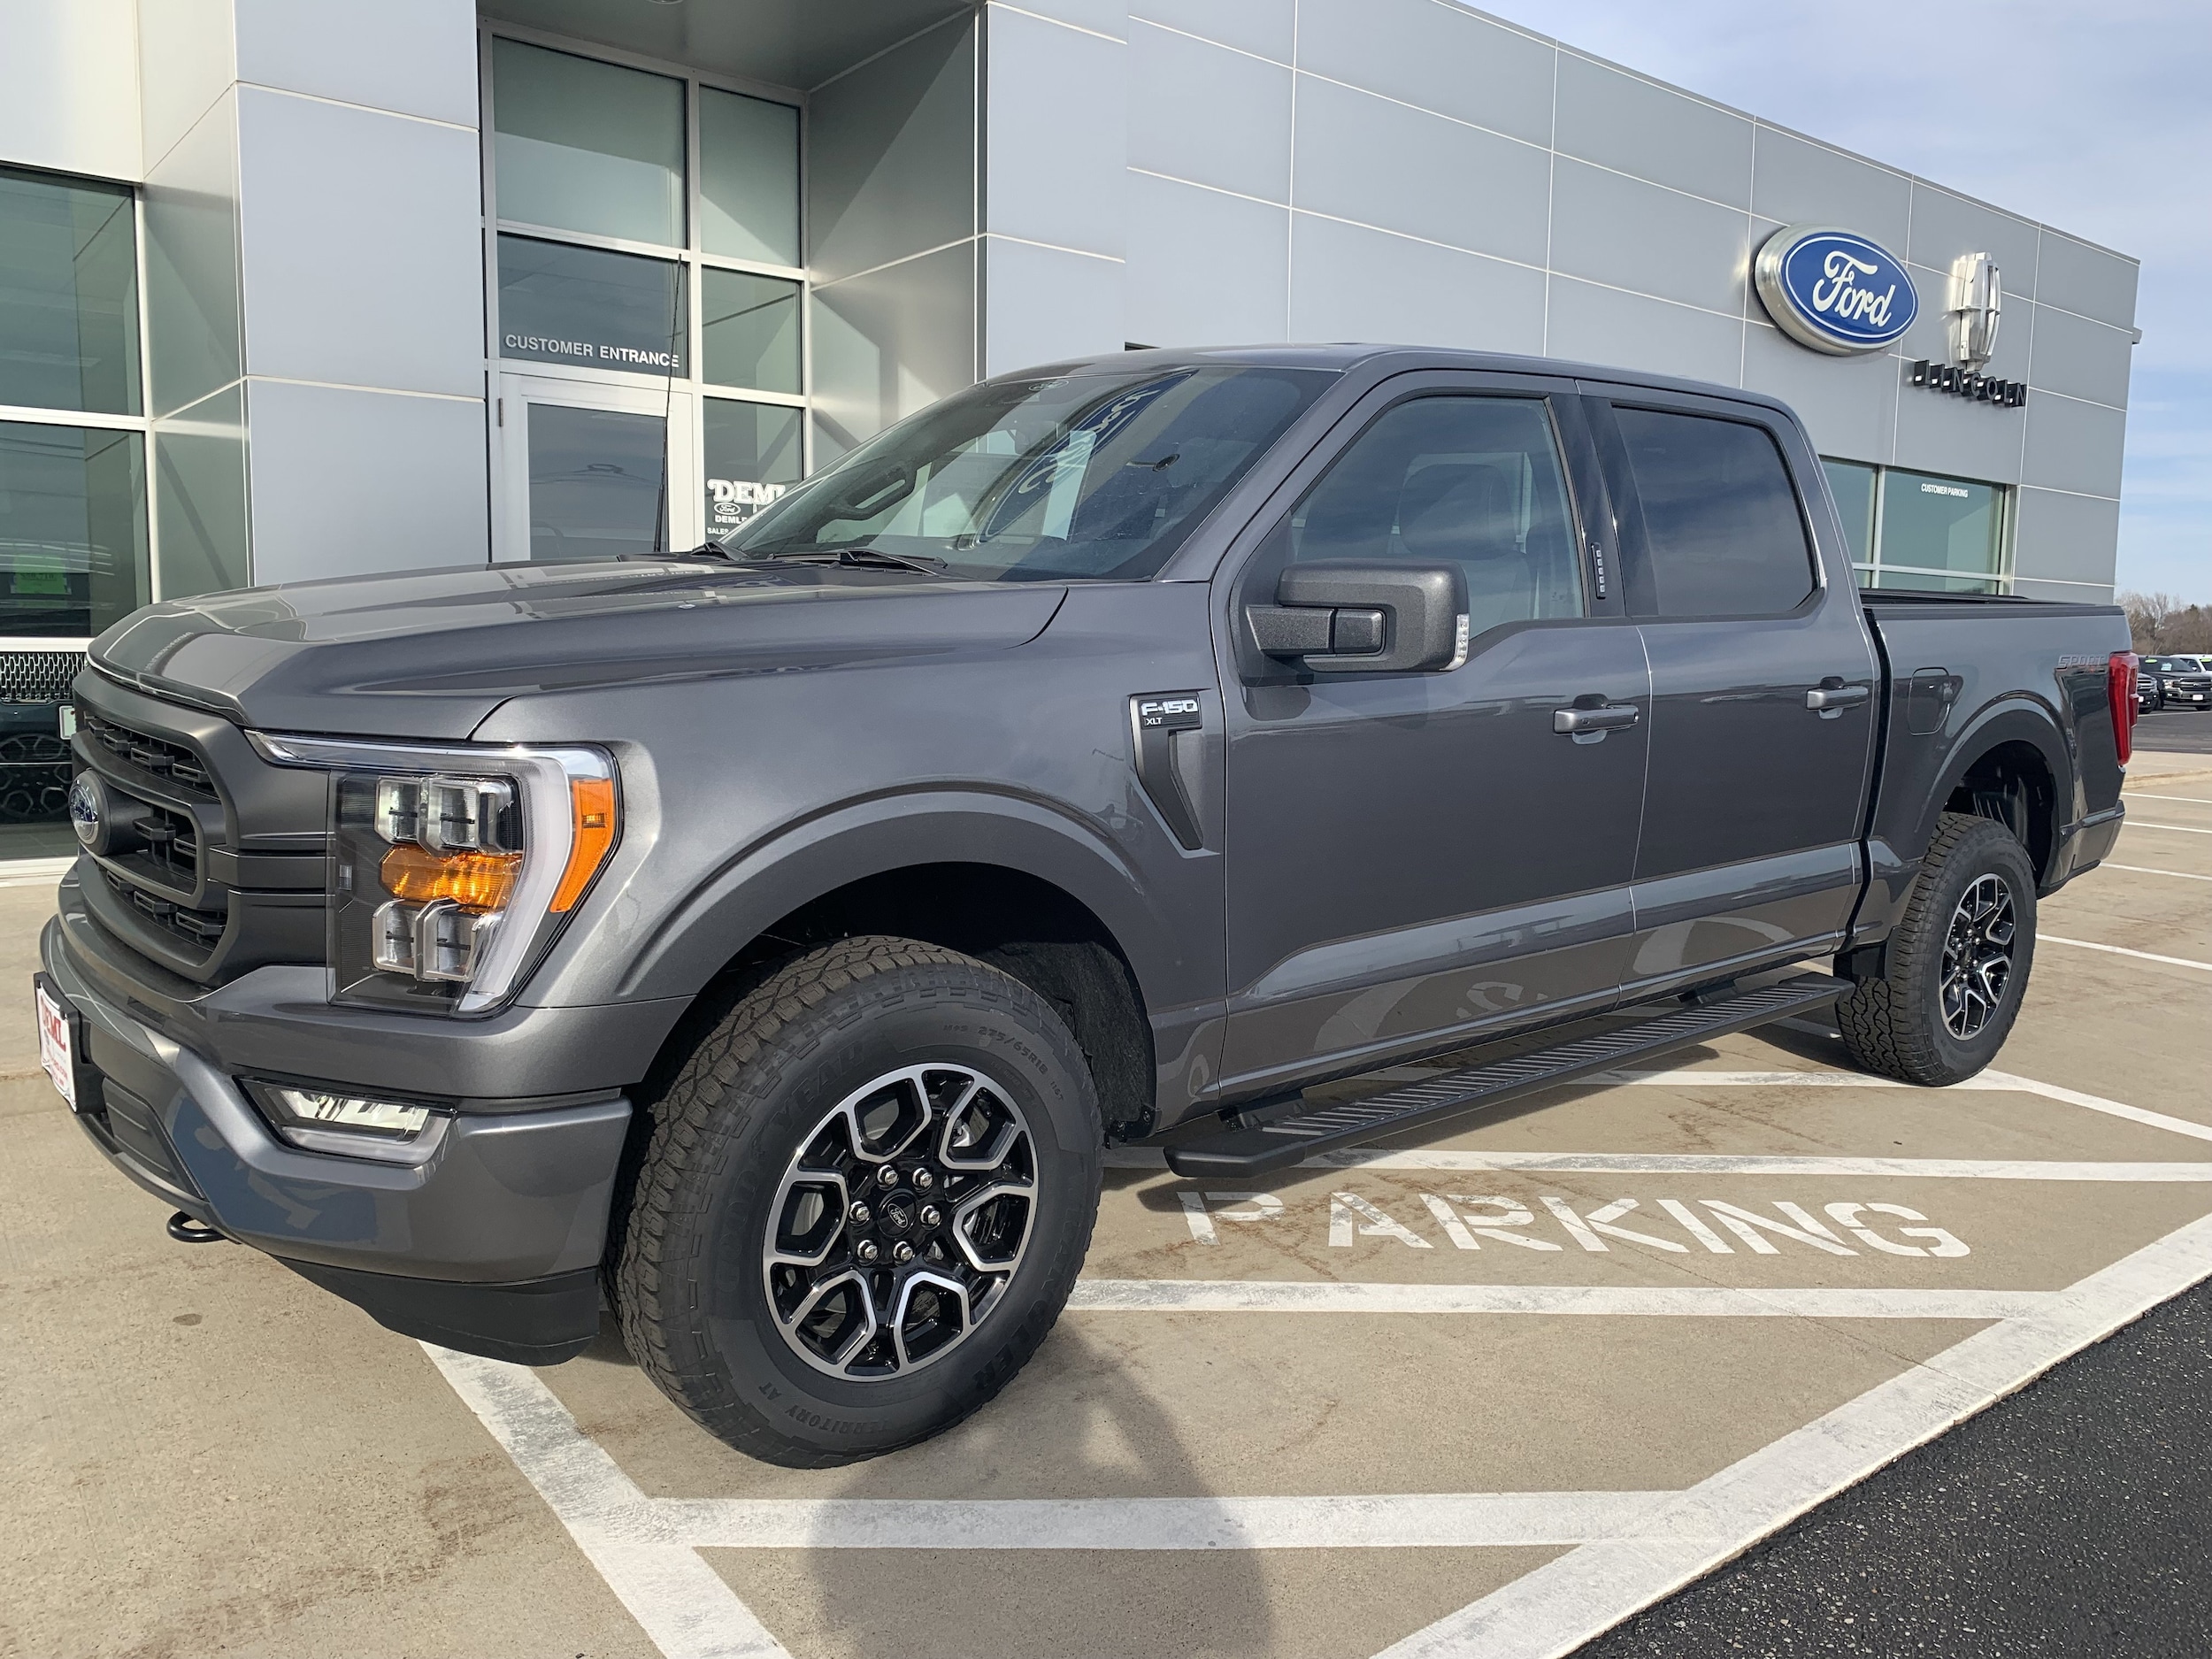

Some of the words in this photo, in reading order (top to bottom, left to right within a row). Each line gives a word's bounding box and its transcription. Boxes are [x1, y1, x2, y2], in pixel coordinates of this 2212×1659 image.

[1813, 250, 1896, 327] Ford
[505, 334, 593, 357] CUSTOMER
[600, 345, 679, 368] ENTRANCE
[1914, 359, 2027, 407] LINCOLN
[1921, 483, 1947, 495] CUSTOMER
[1947, 488, 1969, 498] PARKING
[2057, 655, 2106, 667] SPORT
[1141, 699, 1199, 716] F-150
[890, 1208, 906, 1225] Ford
[1178, 1190, 1971, 1258] PARKING
